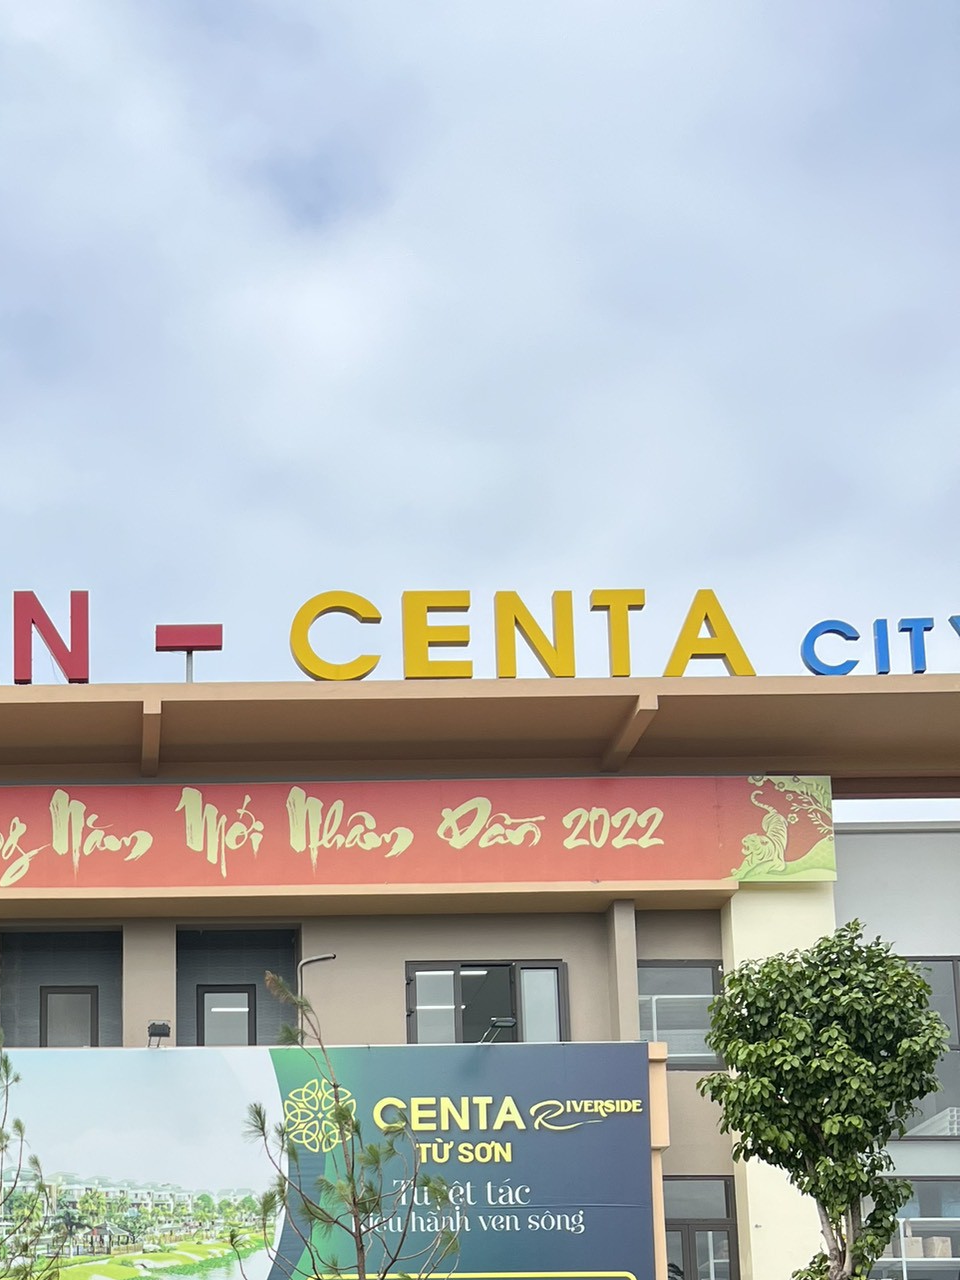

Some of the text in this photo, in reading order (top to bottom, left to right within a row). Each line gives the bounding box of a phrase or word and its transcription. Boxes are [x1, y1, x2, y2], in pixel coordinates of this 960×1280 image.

[290, 588, 757, 681] CENTA
[50, 788, 153, 880] Năm
[175, 786, 263, 878] Mới
[562, 806, 665, 850] 2022
[372, 1095, 643, 1132] CENTA RIVERSIDE
[416, 1141, 513, 1164] TỪ SƠN
[392, 1177, 531, 1211] Tuệt tác
[477, 1215, 520, 1232] ven
[527, 1209, 585, 1235] sông
